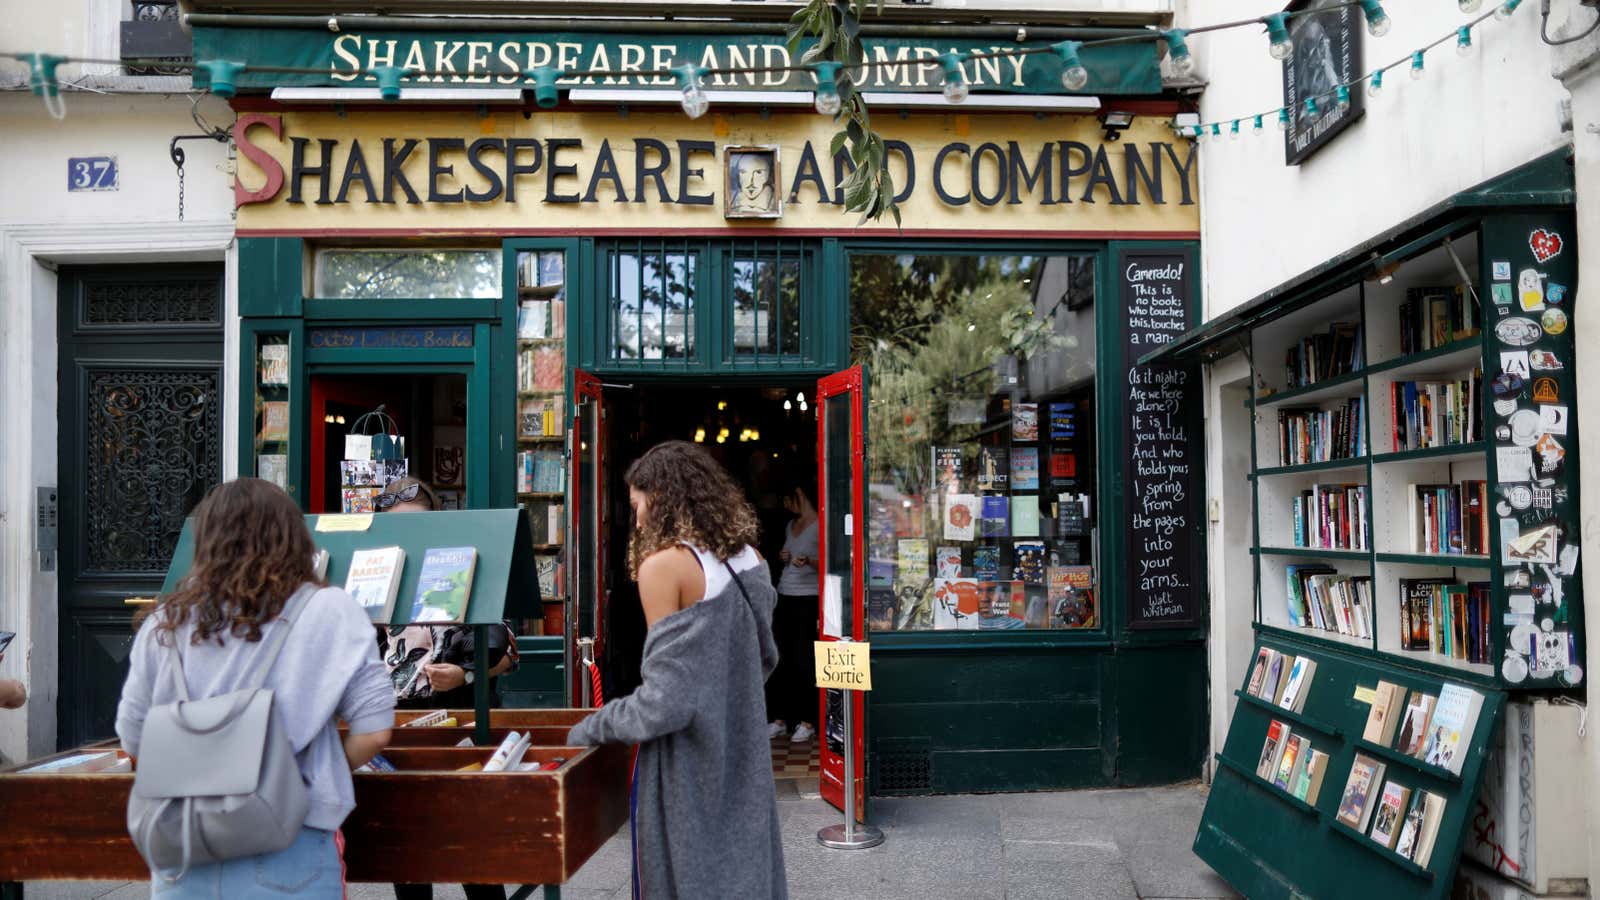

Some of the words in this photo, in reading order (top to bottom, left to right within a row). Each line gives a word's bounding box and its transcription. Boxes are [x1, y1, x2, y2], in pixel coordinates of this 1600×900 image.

[331, 34, 677, 85] SHAKESPEARE
[698, 44, 791, 86] AND
[234, 112, 715, 208] SHAKESPEARE
[786, 139, 916, 205] AND
[933, 141, 1199, 207] COMPANY
[74, 161, 111, 188] 37
[1126, 262, 1184, 282] Camerado!
[1131, 283, 1157, 297] This
[1162, 283, 1173, 296] is
[1136, 297, 1149, 305] no
[1149, 306, 1185, 318] touches
[1150, 318, 1185, 331] touches
[1130, 333, 1140, 345] a
[1143, 367, 1153, 384] it
[1155, 370, 1187, 390] night?
[1129, 386, 1147, 401] Are
[1148, 391, 1160, 400] we
[1161, 388, 1184, 400] here
[1136, 399, 1179, 415] alone?)
[1132, 415, 1142, 430] It
[1149, 415, 1161, 428] is
[1134, 433, 1155, 446] you
[1132, 444, 1158, 461] And
[1162, 443, 1184, 459] who
[1137, 459, 1167, 476] holds
[1134, 479, 1139, 497] I
[1146, 480, 1185, 502] spring
[1142, 495, 1173, 515] from
[1133, 513, 1152, 529] the
[1154, 515, 1185, 535] pages
[1144, 534, 1173, 553] into
[1140, 556, 1173, 577] your
[1148, 592, 1174, 606] Walt
[1142, 604, 1185, 618] Whitman
[826, 647, 856, 666] Exit
[822, 665, 864, 685] Sortie
